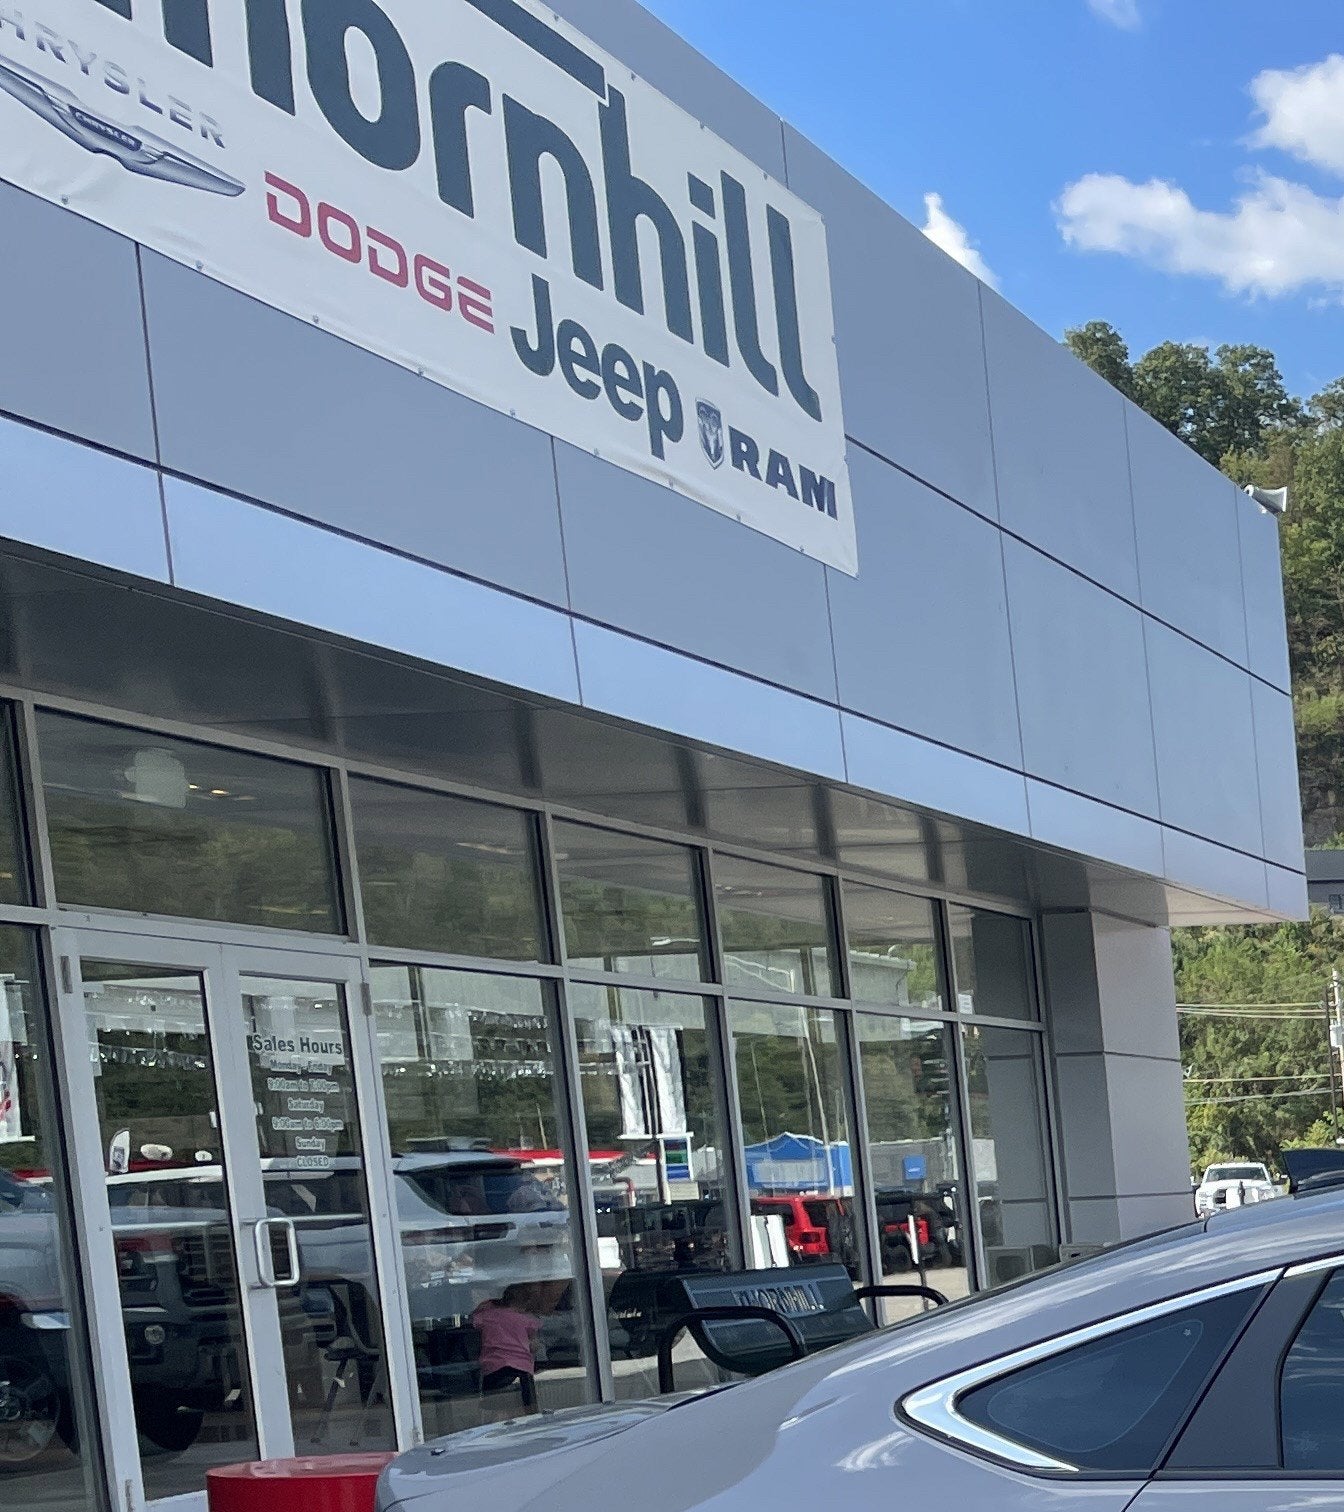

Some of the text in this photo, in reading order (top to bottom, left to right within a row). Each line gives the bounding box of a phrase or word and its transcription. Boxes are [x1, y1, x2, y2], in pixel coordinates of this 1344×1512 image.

[0, 10, 226, 149] HRYSLER
[94, 0, 821, 421] ornhill
[264, 170, 495, 334] DODGE
[510, 273, 684, 461] Jeep
[730, 424, 838, 521] RAM
[253, 1034, 343, 1055] Sales Hours
[288, 1098, 324, 1113] Saturday
[295, 1136, 326, 1152] Sunday
[297, 1156, 329, 1167] CLOSED
